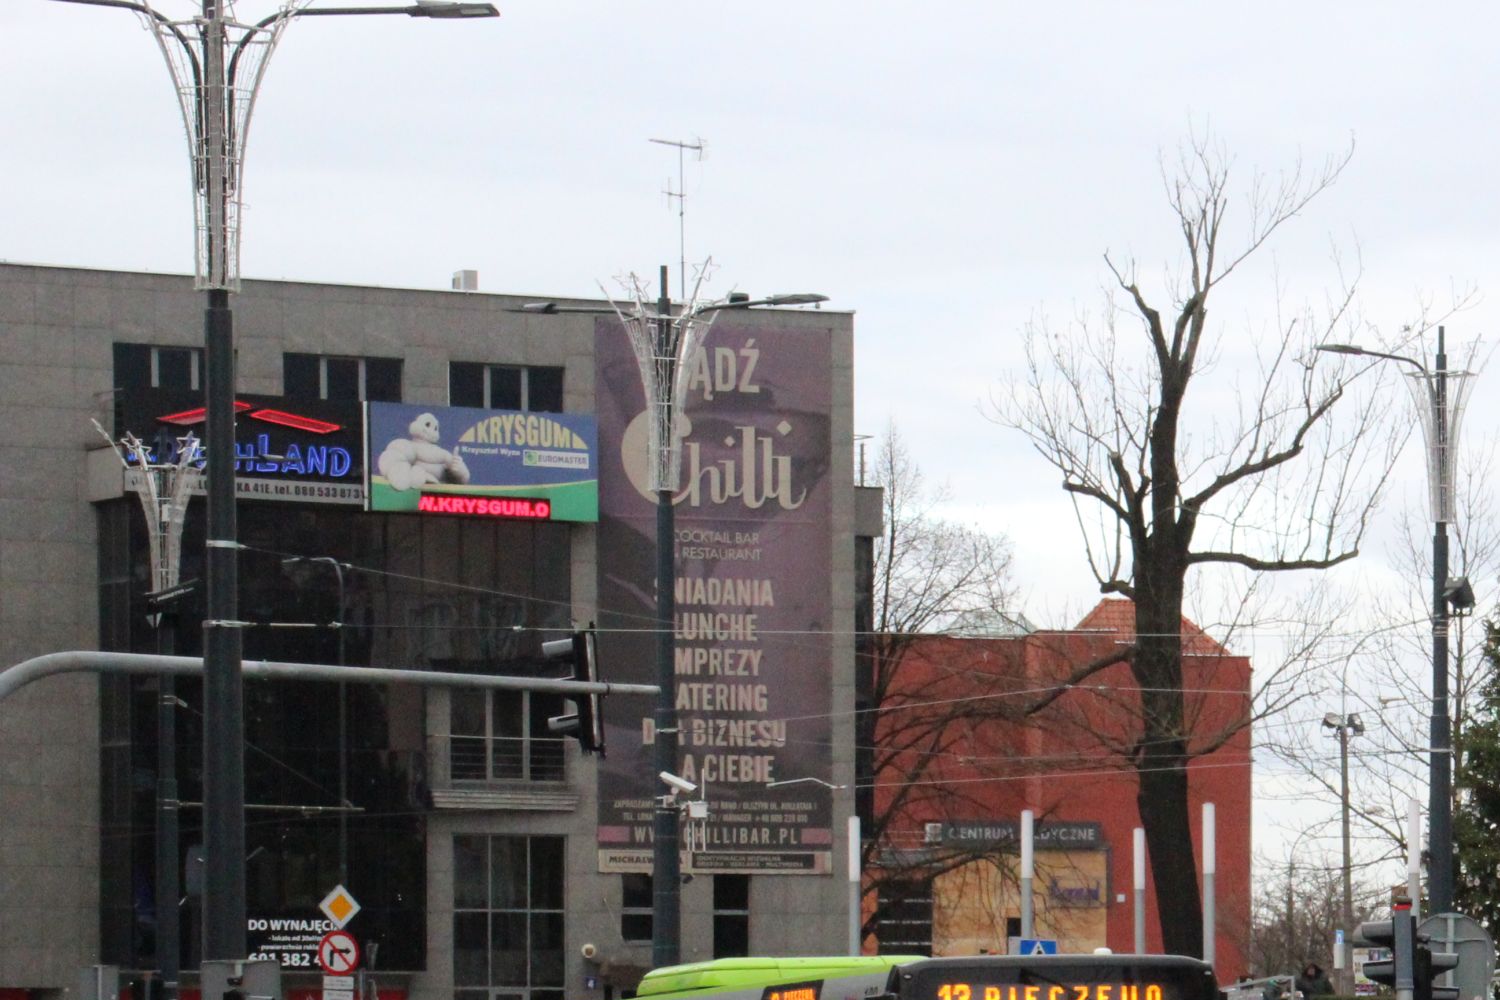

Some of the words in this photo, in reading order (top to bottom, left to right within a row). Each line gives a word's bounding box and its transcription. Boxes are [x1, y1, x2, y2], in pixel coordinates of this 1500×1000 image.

[689, 338, 760, 400] ĄDŹ
[477, 414, 571, 449] KRYSGUM
[538, 454, 587, 465] EUROMASTER
[621, 410, 806, 510] Chilli
[674, 530, 731, 543] COCKTAIL
[736, 532, 759, 543] BAR
[682, 547, 762, 560] RESTAURANT
[654, 577, 774, 607] NIADANIA
[674, 647, 763, 677] MPREZY
[675, 683, 768, 712] ATERING
[692, 719, 786, 748] BIZNESU
[703, 754, 775, 783] CIEBIE
[248, 919, 267, 931] DO
[281, 952, 310, 967] 382
